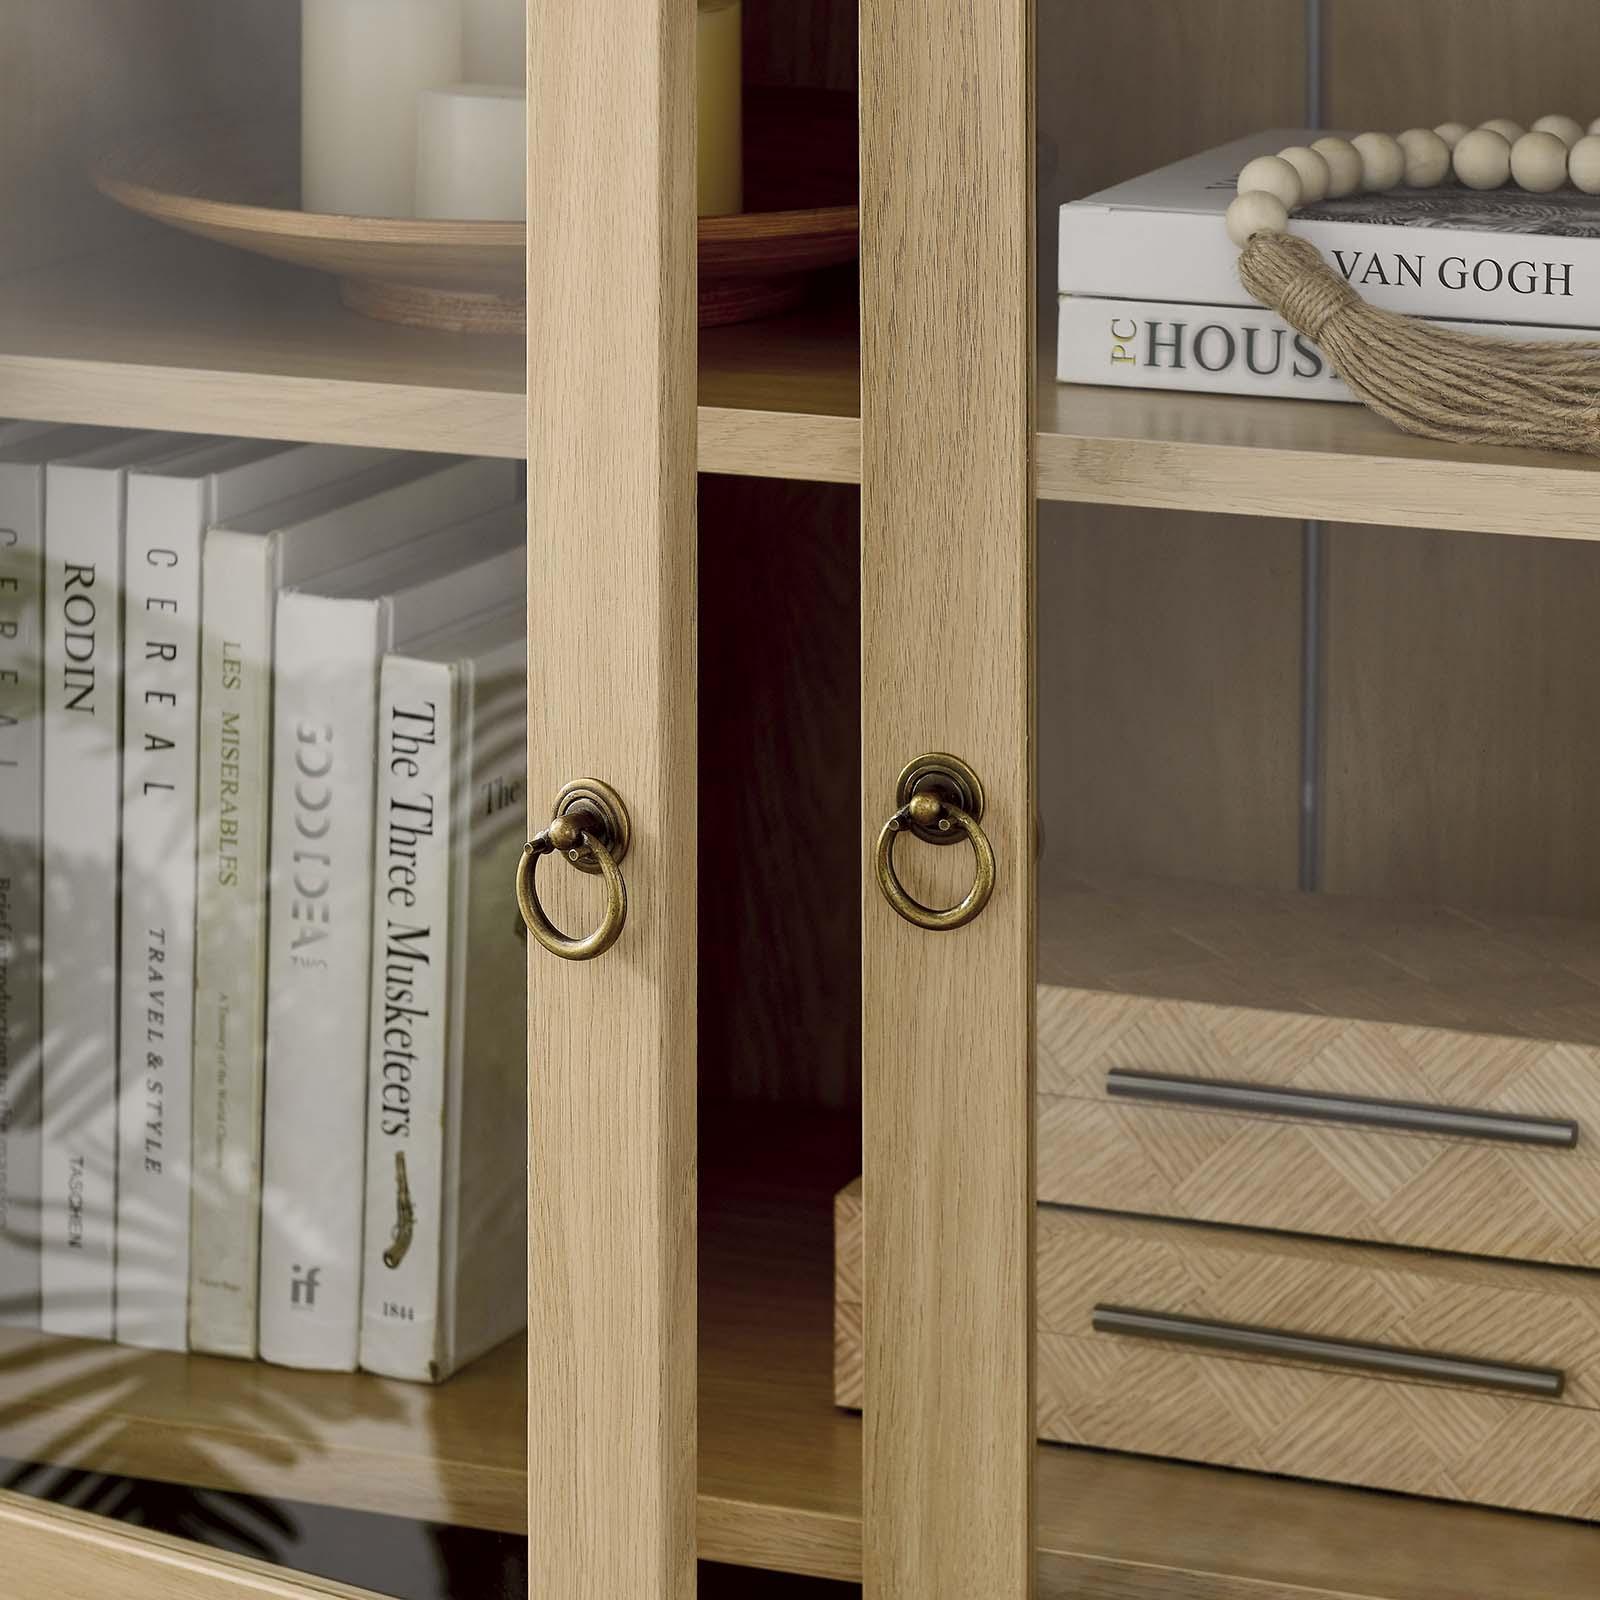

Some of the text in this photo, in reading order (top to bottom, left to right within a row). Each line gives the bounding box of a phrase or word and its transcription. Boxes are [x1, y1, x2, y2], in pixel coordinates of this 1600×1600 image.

[1331, 249, 1575, 297] VAN GOGH
[1111, 318, 1137, 365] PC
[1144, 320, 1342, 380] HOUS
[64, 562, 96, 715] RODIN
[144, 548, 178, 795] CEREAL
[218, 640, 241, 888] LES MISERABLES
[480, 775, 521, 816] The
[381, 701, 436, 1138] The Three Musketeers
[145, 927, 165, 1175] TRAVEL & STYLE
[68, 1155, 85, 1249] TASCHEN
[290, 1263, 321, 1304] if
